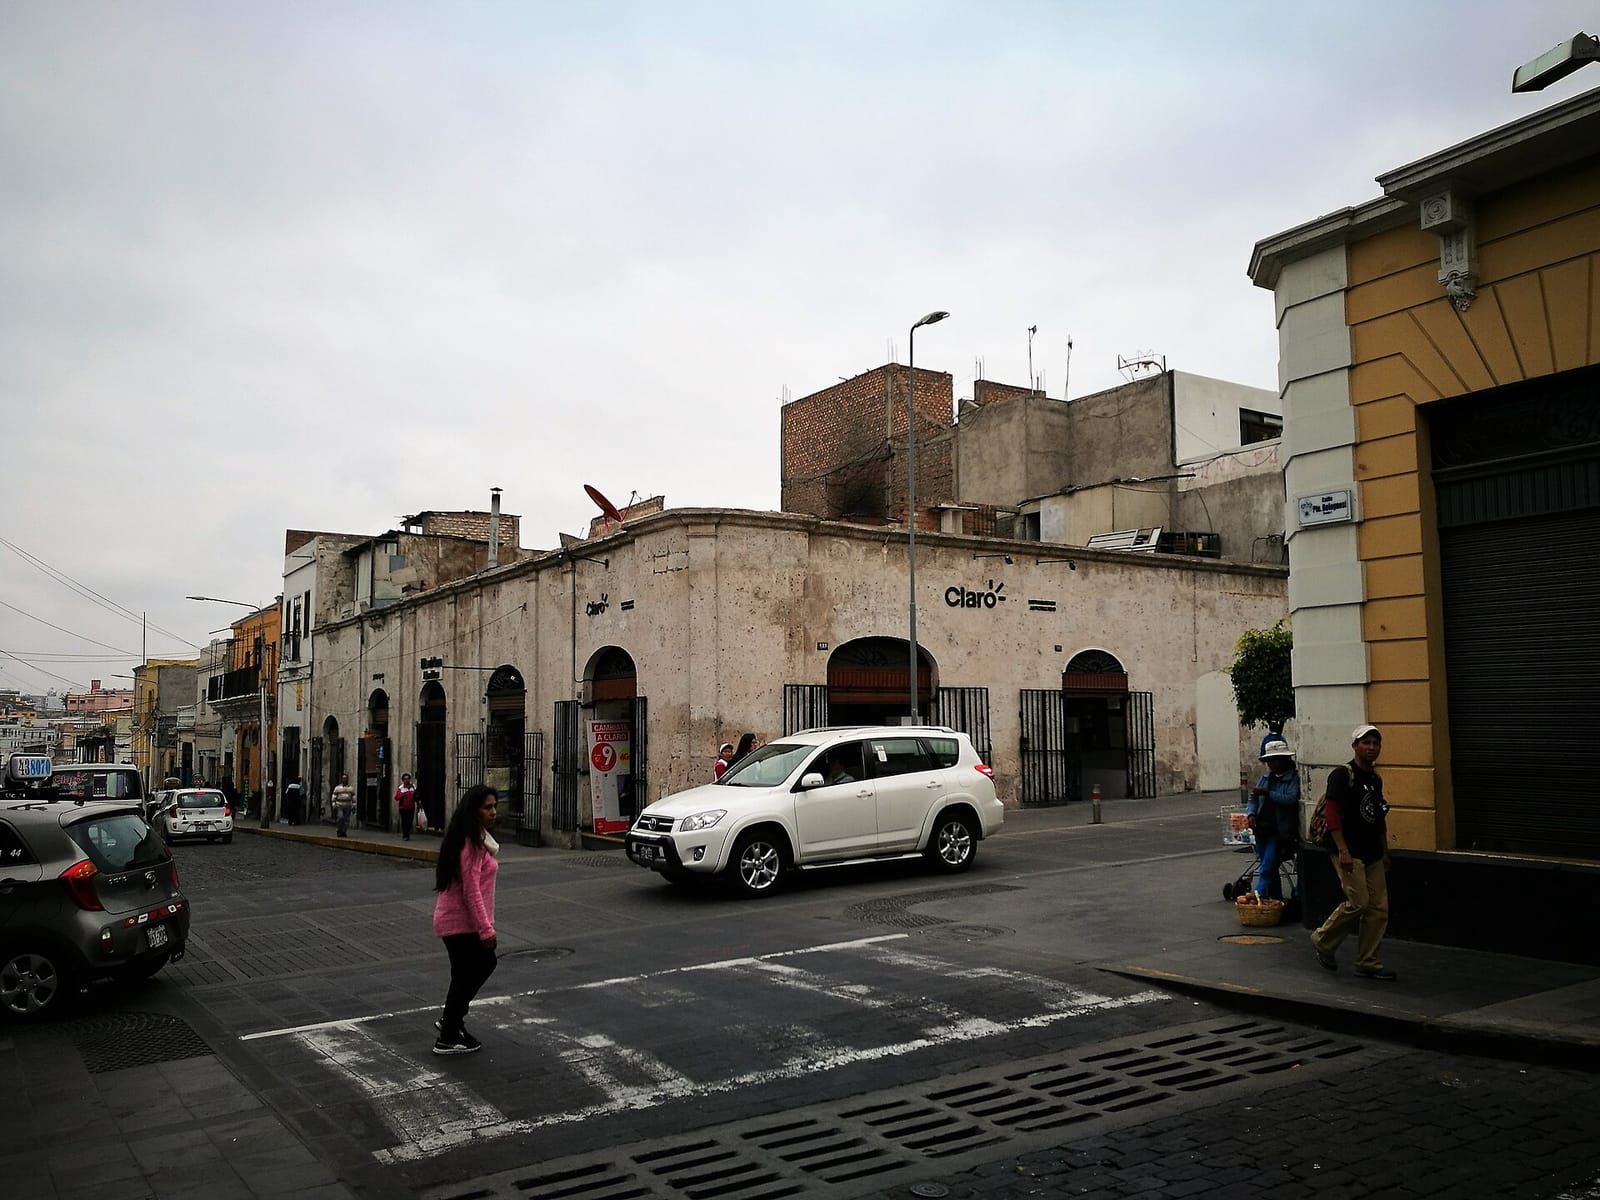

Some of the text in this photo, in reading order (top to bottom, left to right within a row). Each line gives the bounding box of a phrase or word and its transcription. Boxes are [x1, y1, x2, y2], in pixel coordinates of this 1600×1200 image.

[944, 583, 998, 609] Claro
[585, 598, 607, 617] Claro
[597, 732, 627, 742] A CLARO
[602, 745, 614, 766] 9
[18, 758, 51, 776] 438070
